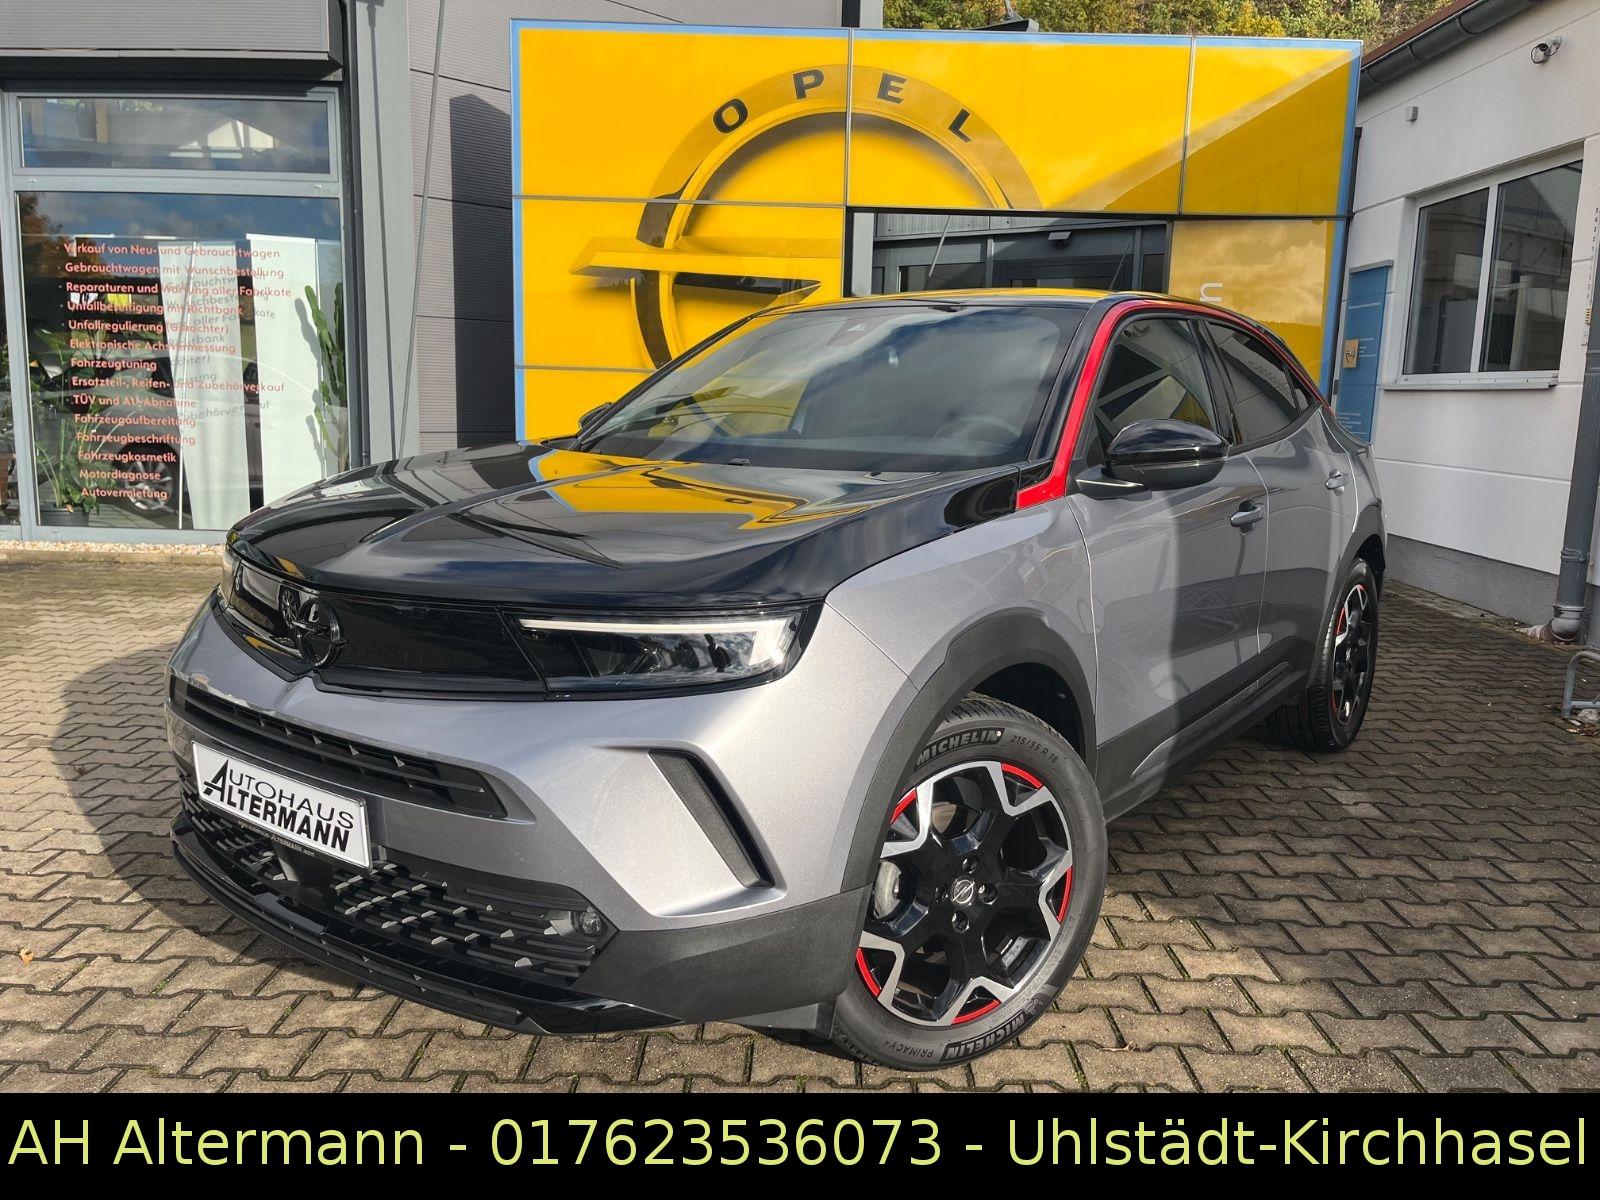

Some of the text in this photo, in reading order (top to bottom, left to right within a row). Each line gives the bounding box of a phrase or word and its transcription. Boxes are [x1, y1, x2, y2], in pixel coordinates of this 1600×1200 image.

[713, 69, 972, 143] OPEL
[63, 243, 280, 260] Verkauf von Neu- und Gebrauchtwagen
[65, 262, 284, 279] Gebrauchtwagen mit Wunschbestellung
[66, 282, 134, 295] Reparaturen
[137, 284, 158, 294] und
[212, 286, 236, 296] aller
[240, 286, 292, 297] Fabrikate
[188, 304, 244, 316] Richtbank
[68, 320, 164, 334] Unfallregulierung
[69, 339, 236, 355] Elektronische Achsvermessung
[70, 357, 157, 372] Fahrzeugtuning
[132, 378, 170, 389] Reifen-
[174, 379, 194, 389] und
[73, 393, 96, 404] TÜV
[98, 395, 119, 405] und
[74, 414, 196, 427] Fahrzeugaufbereitung
[76, 432, 196, 446] Fahrzeugbeschriftung
[78, 451, 177, 464] Fahrzeugkosmetik
[79, 469, 161, 480] Motordiagnose
[81, 487, 168, 500] Autovermietung
[915, 730, 999, 767] MICHELIN
[1011, 734, 1040, 751] 215/55
[203, 759, 350, 852] ALTERMANN
[945, 1013, 1025, 1059] MICHELIN
